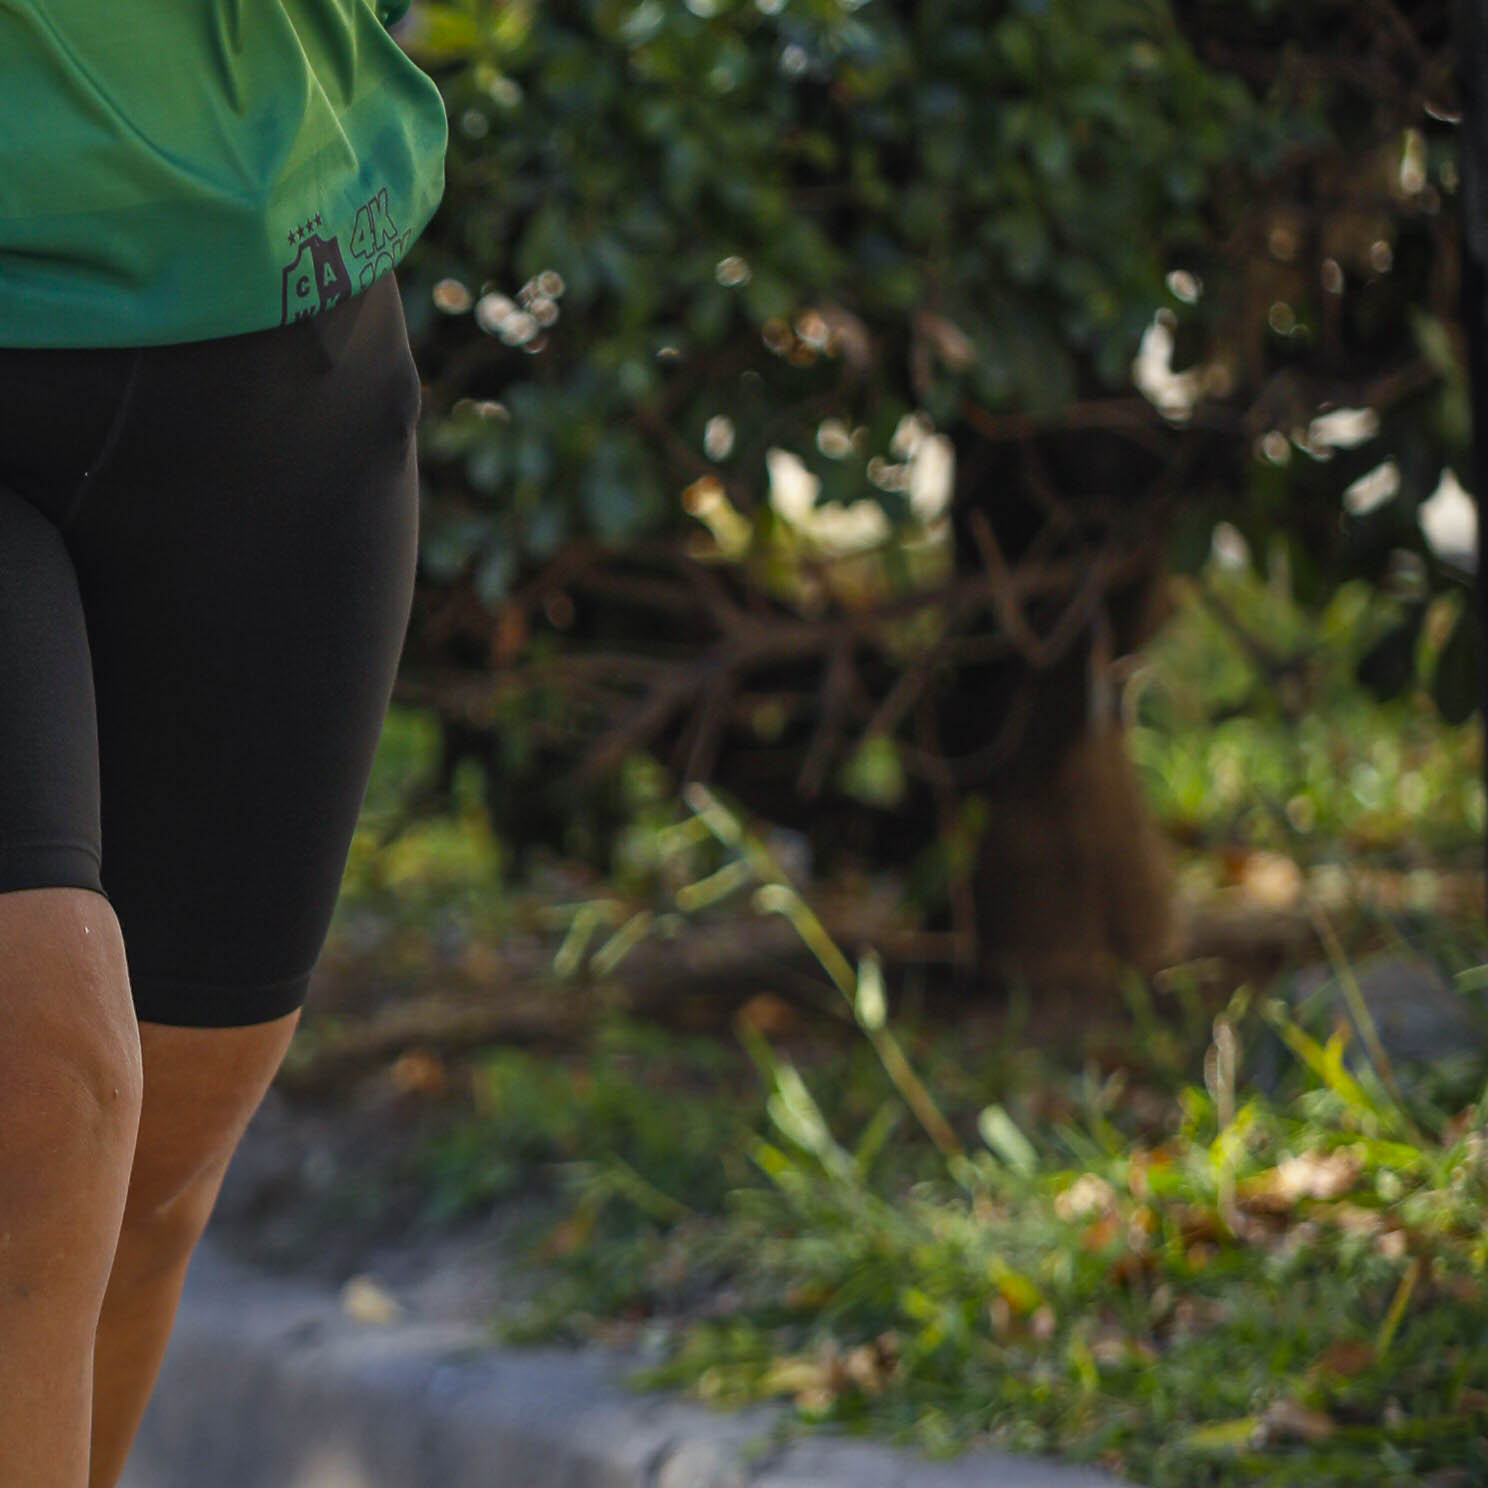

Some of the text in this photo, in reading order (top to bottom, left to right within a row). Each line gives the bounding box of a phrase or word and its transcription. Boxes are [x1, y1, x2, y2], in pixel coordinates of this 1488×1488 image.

[350, 187, 398, 259] 4K
[296, 261, 338, 298] C A
